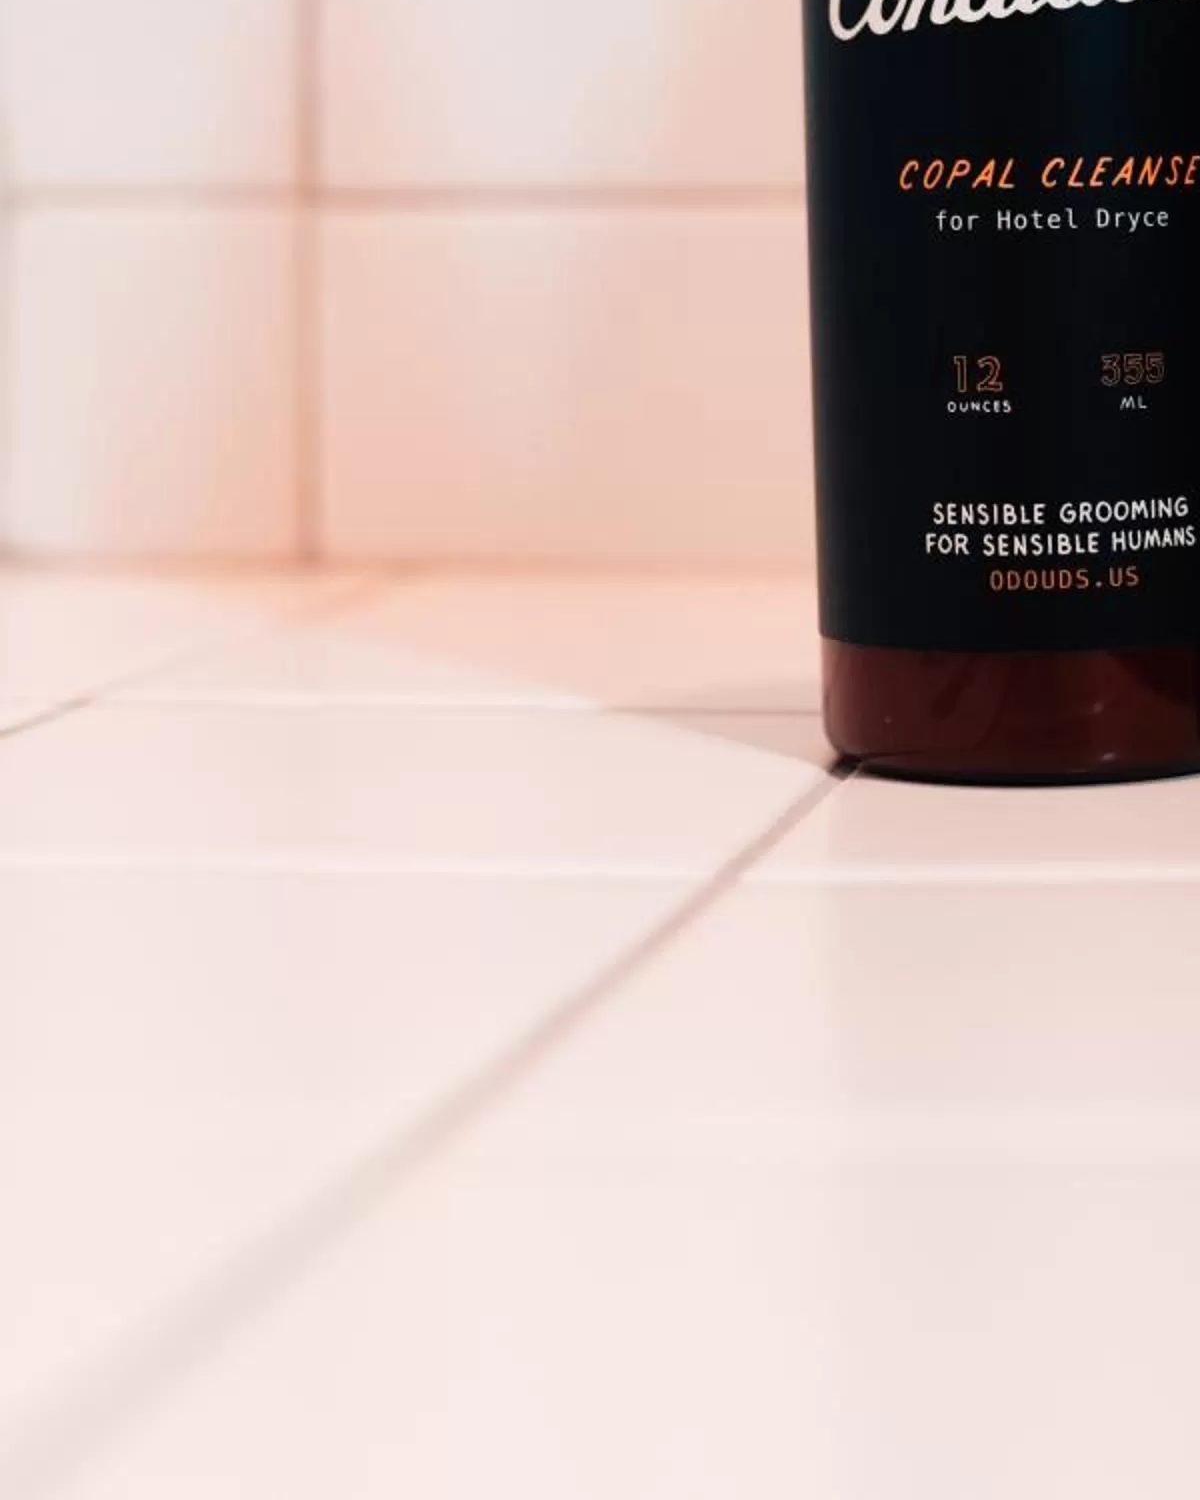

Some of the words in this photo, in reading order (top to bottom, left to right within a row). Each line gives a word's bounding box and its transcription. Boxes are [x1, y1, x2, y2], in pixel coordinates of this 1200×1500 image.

[899, 158, 1015, 190] COPAL
[1041, 155, 1200, 188] CLEANSE
[935, 207, 980, 232] for
[996, 207, 1078, 231] Hotel
[1096, 207, 1169, 233] Dryce
[953, 355, 1004, 393] 12
[1100, 352, 1165, 387] 355
[947, 399, 1012, 413] OUNCES
[1119, 395, 1148, 410] ML
[933, 502, 1046, 526] SENSIBLE
[1059, 496, 1189, 524] GROOMING
[925, 532, 970, 555] FOR
[982, 531, 1100, 557] SENSIBLE
[1111, 525, 1196, 552] HUMANS
[989, 565, 1139, 591] ODOUDS.US
